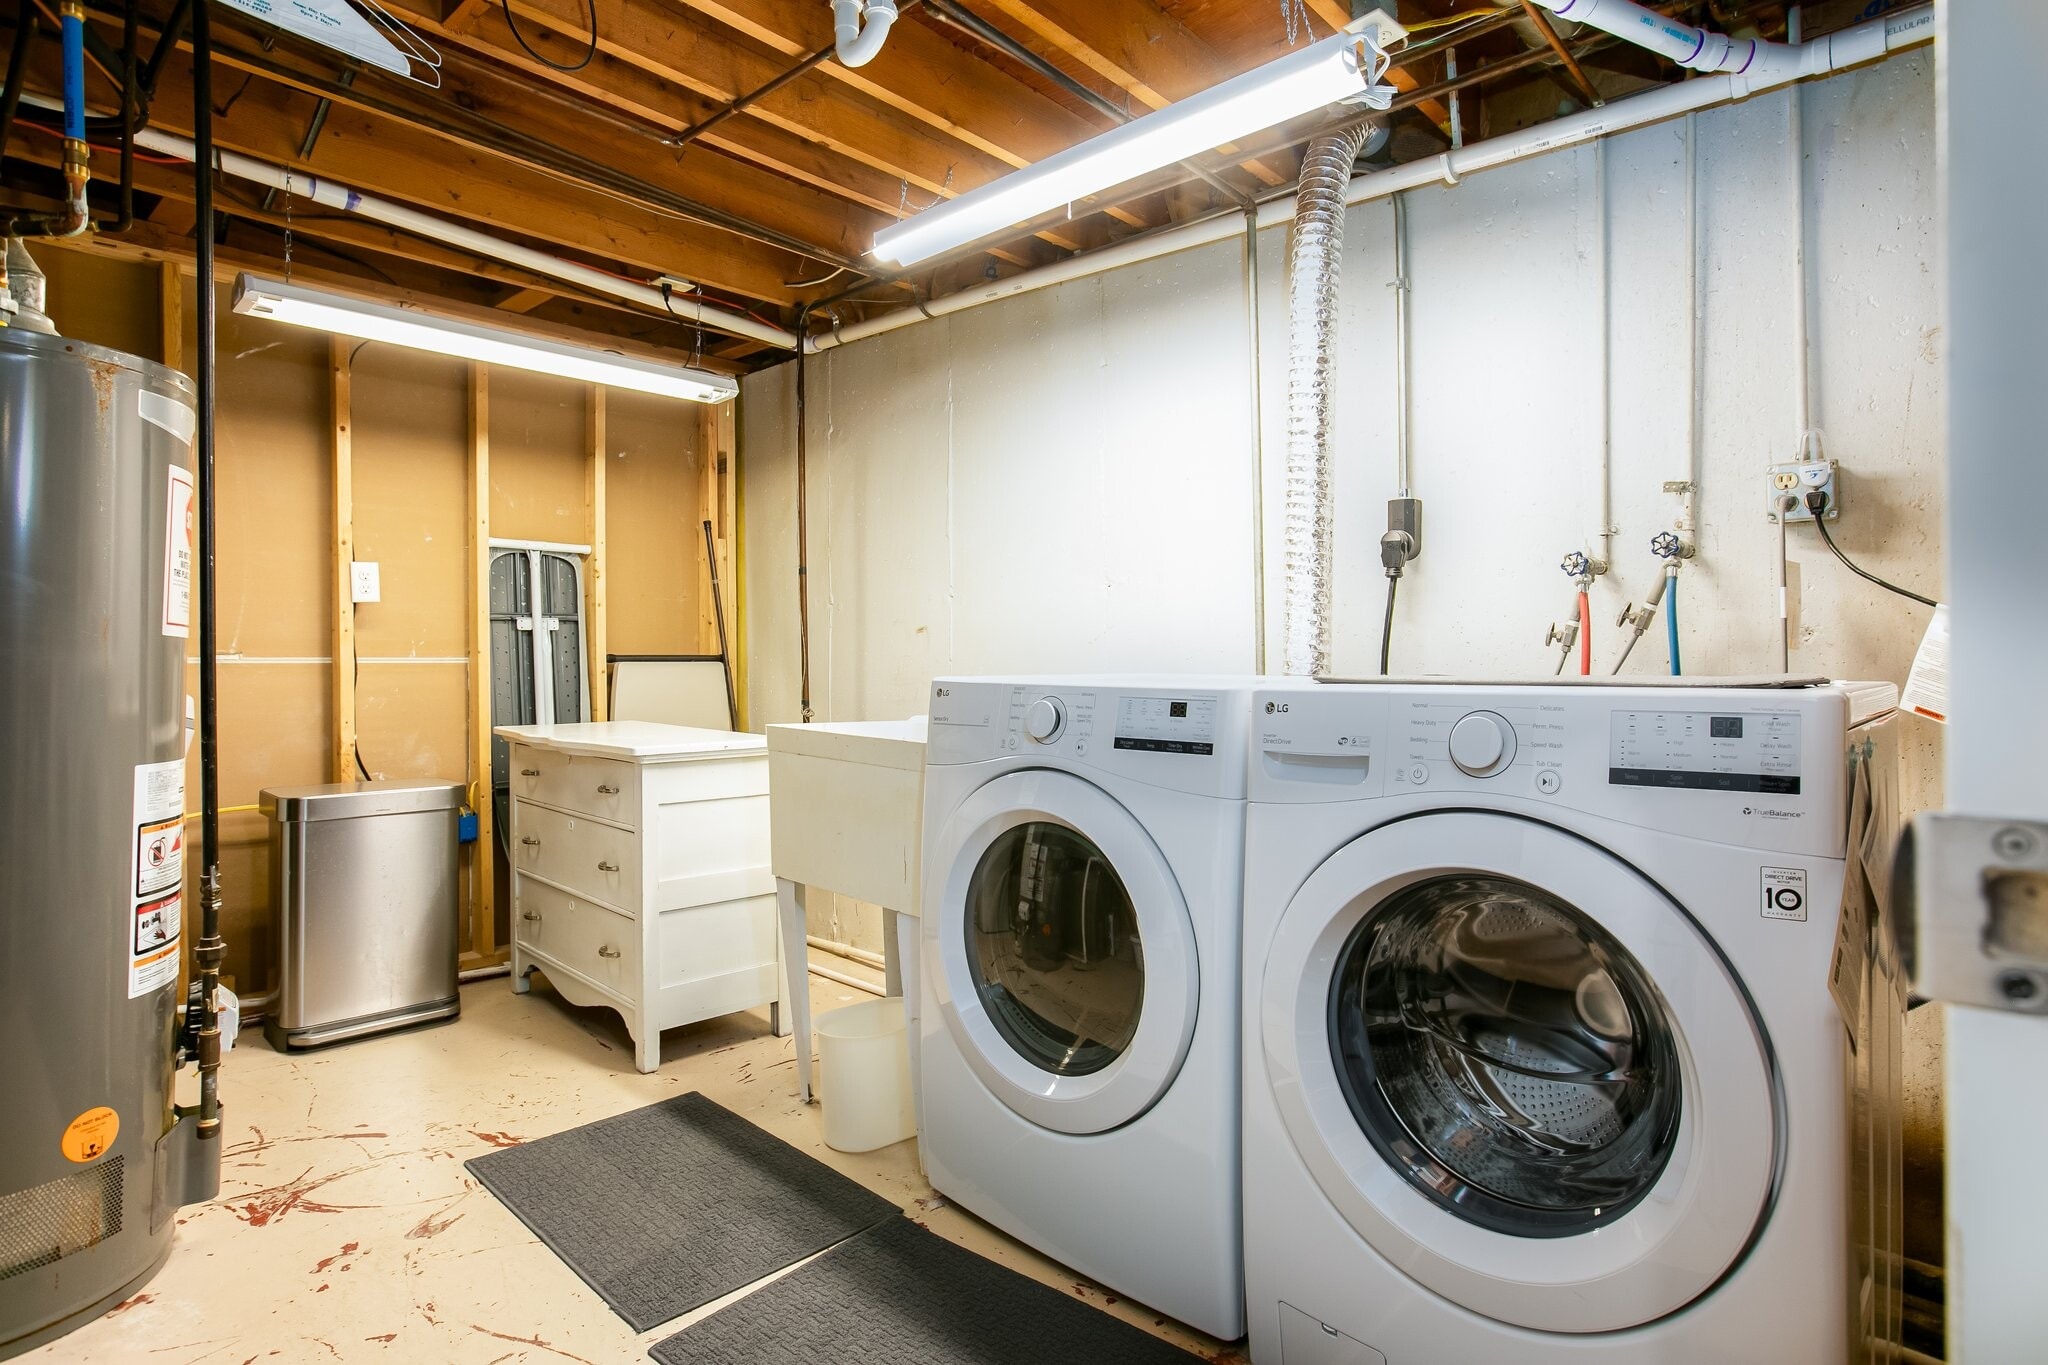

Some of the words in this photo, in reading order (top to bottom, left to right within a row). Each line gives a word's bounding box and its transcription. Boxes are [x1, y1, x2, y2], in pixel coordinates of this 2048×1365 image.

[1885, 16, 1930, 36] ELLULAR
[1277, 703, 1289, 713] LG
[1765, 887, 1802, 911] 10
